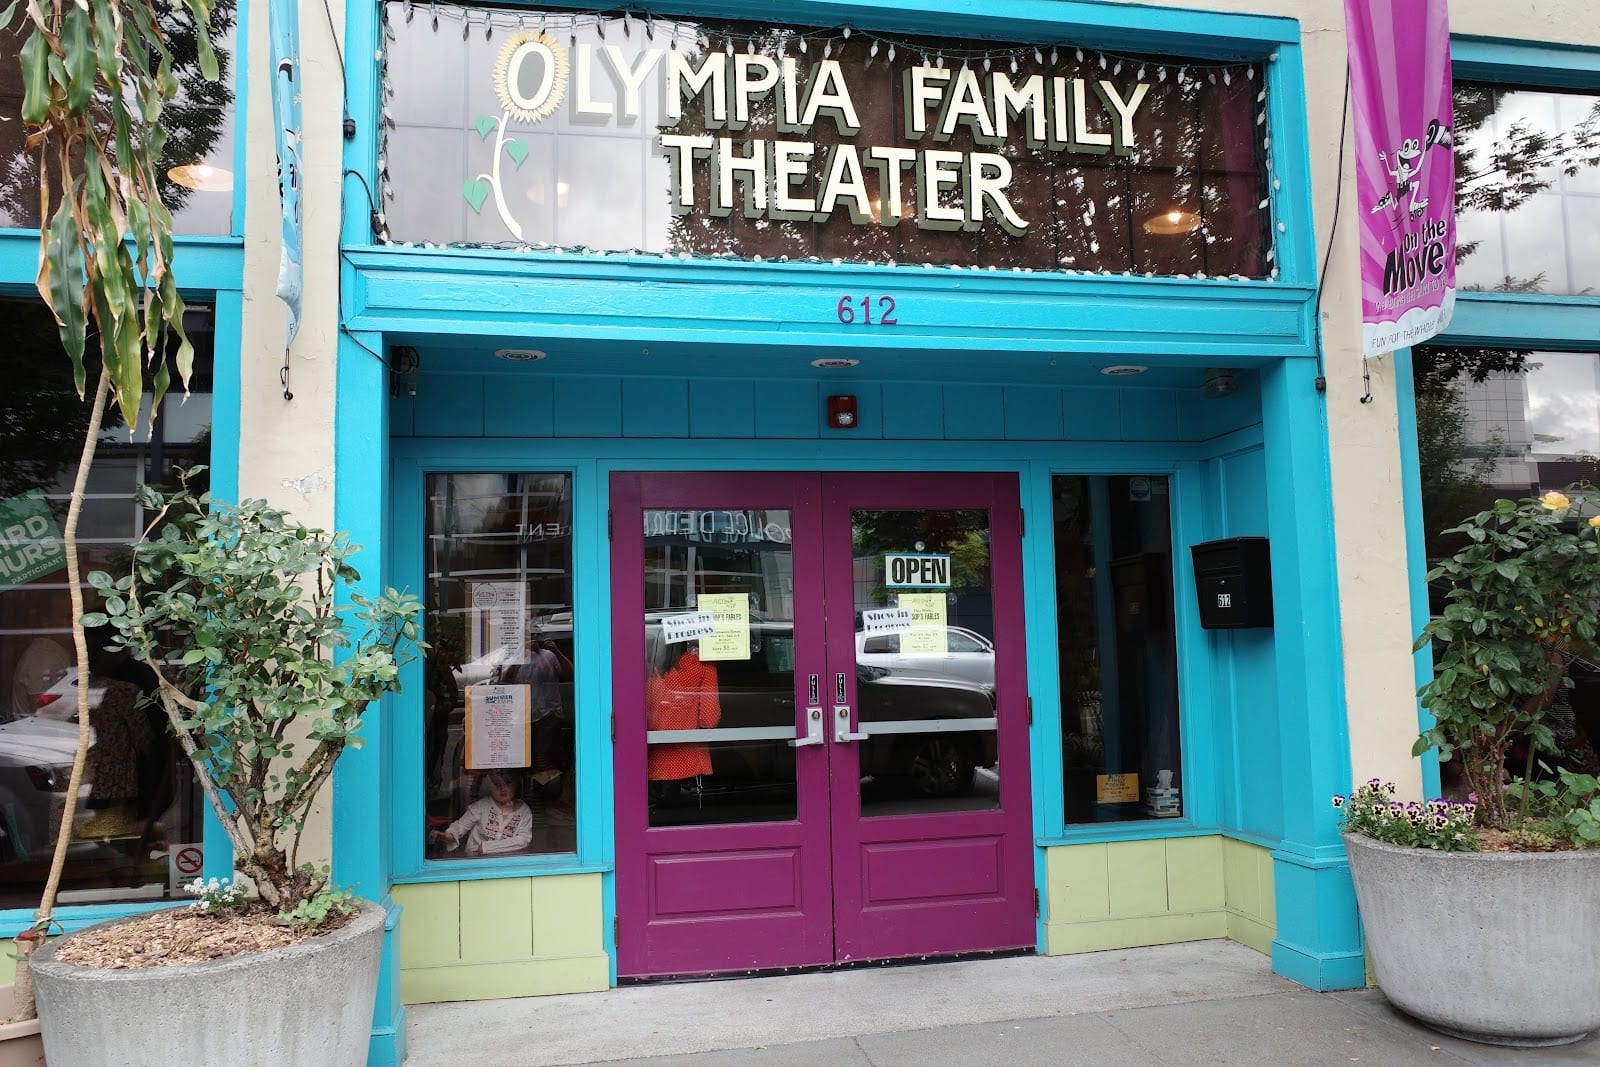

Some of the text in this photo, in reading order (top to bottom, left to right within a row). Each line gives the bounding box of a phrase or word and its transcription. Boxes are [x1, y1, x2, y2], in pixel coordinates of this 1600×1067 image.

[505, 40, 1150, 149] OLYMPIA FAMILY
[660, 134, 1029, 231] THEATER
[1422, 217, 1447, 246] the
[836, 295, 898, 326] 612
[0, 515, 49, 554] IRD
[11, 555, 65, 585] PARTICIPANT
[891, 557, 947, 584] OPEN
[1218, 595, 1231, 607] 612
[725, 613, 742, 621] FABLES
[925, 612, 940, 620] FABLES
